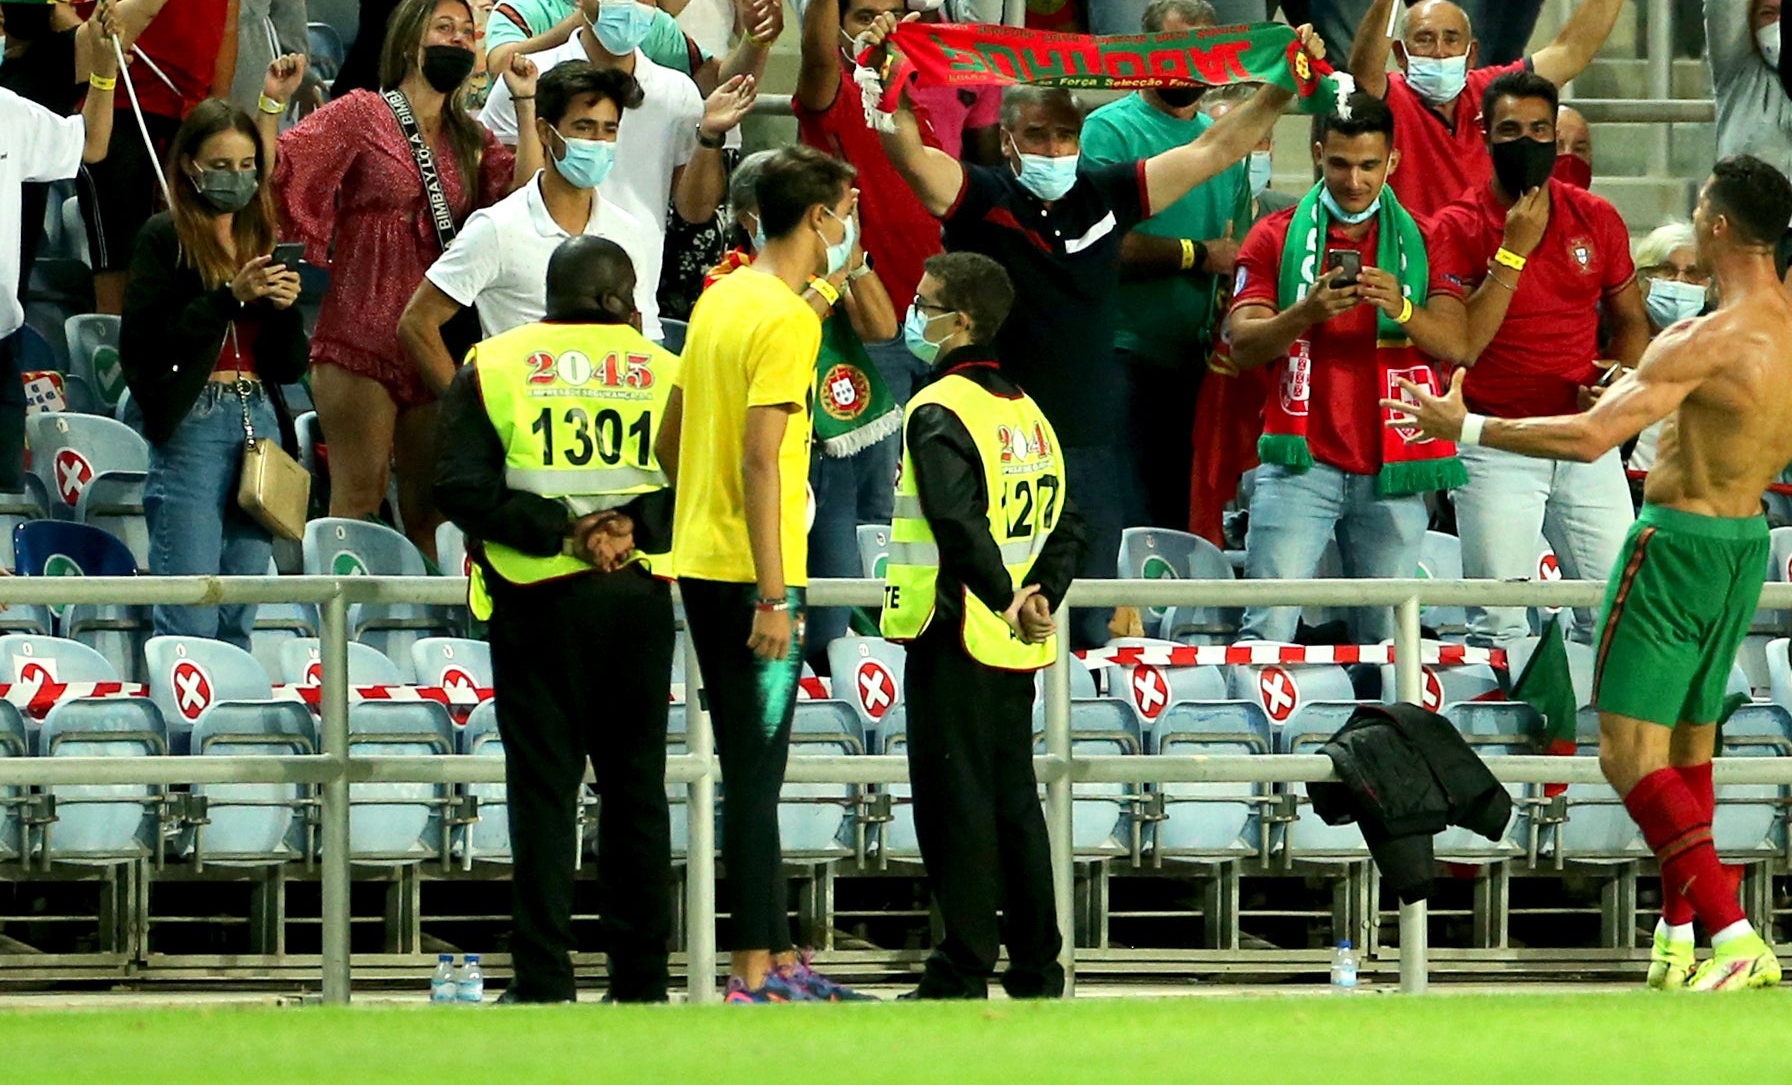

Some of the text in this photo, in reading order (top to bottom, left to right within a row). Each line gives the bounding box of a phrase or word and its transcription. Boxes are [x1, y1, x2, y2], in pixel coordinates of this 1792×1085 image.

[1059, 77, 1098, 88] Força
[1104, 78, 1163, 88] Selecção
[525, 350, 655, 389] 2045
[532, 407, 652, 466] 1301
[998, 419, 1053, 463] 204
